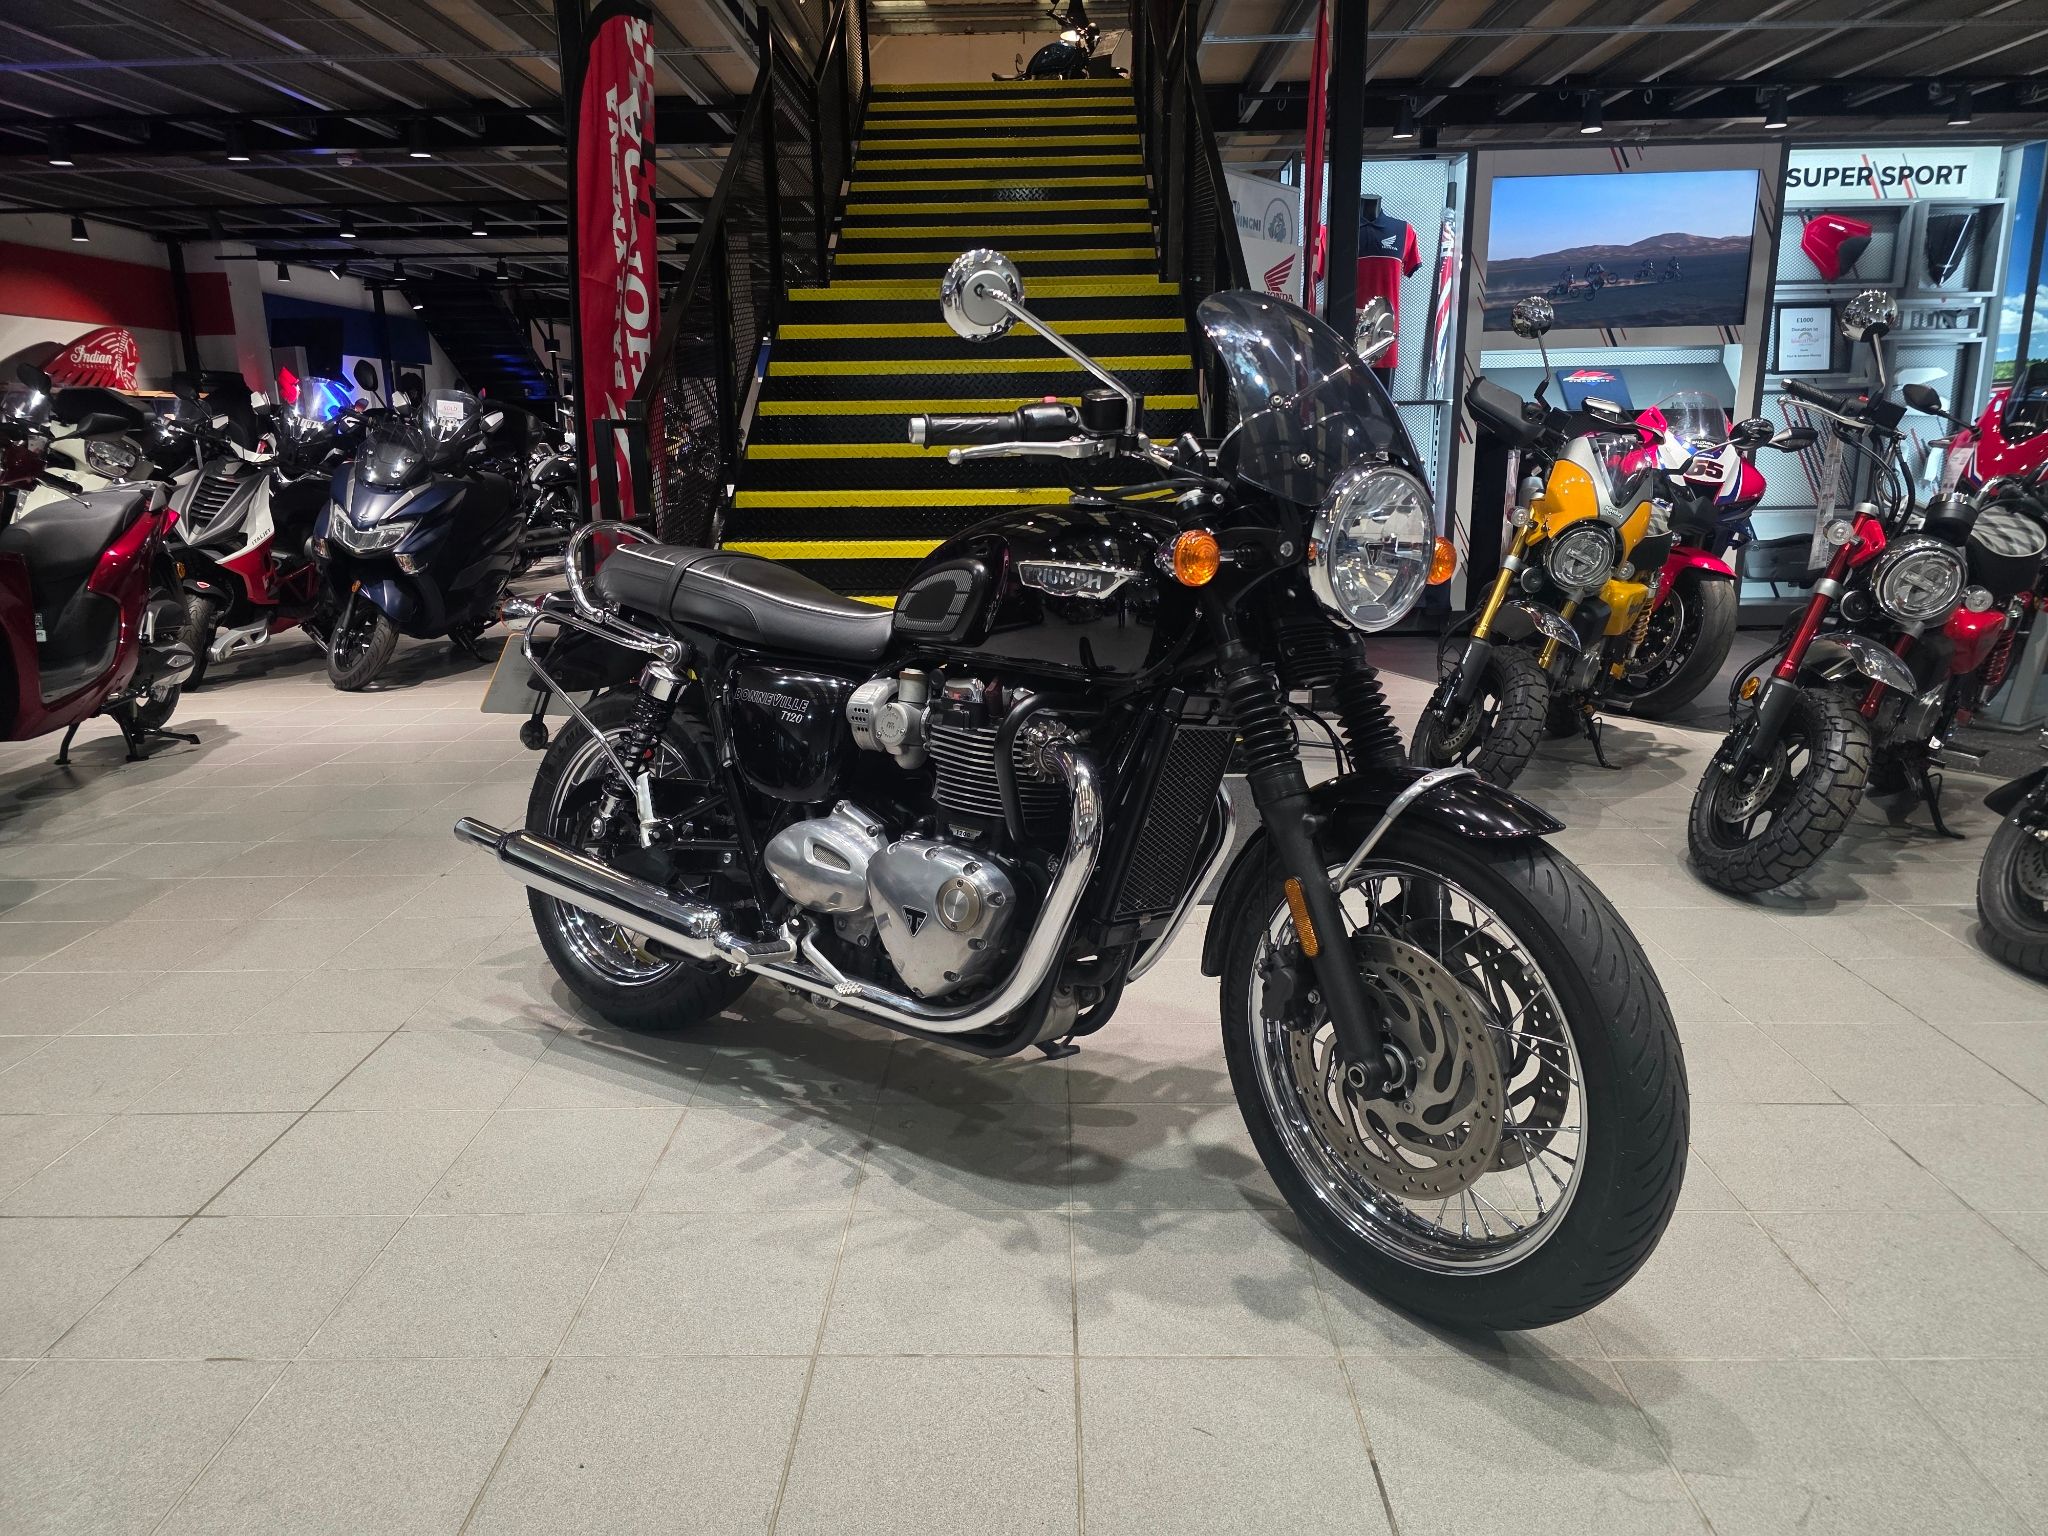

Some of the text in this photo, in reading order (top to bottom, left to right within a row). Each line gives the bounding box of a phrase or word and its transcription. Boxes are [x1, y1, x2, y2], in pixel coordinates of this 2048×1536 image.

[1786, 164, 1968, 187] SUPER SPORT
[606, 82, 627, 390] BALLYMENA
[70, 344, 113, 364] Indian
[1686, 460, 1724, 478] 65
[251, 527, 272, 546] ITALJET
[1023, 566, 1103, 590] TRIUMPH
[734, 687, 810, 713] BONNEVILLE
[780, 710, 804, 724] T120
[956, 829, 971, 837] 1200
